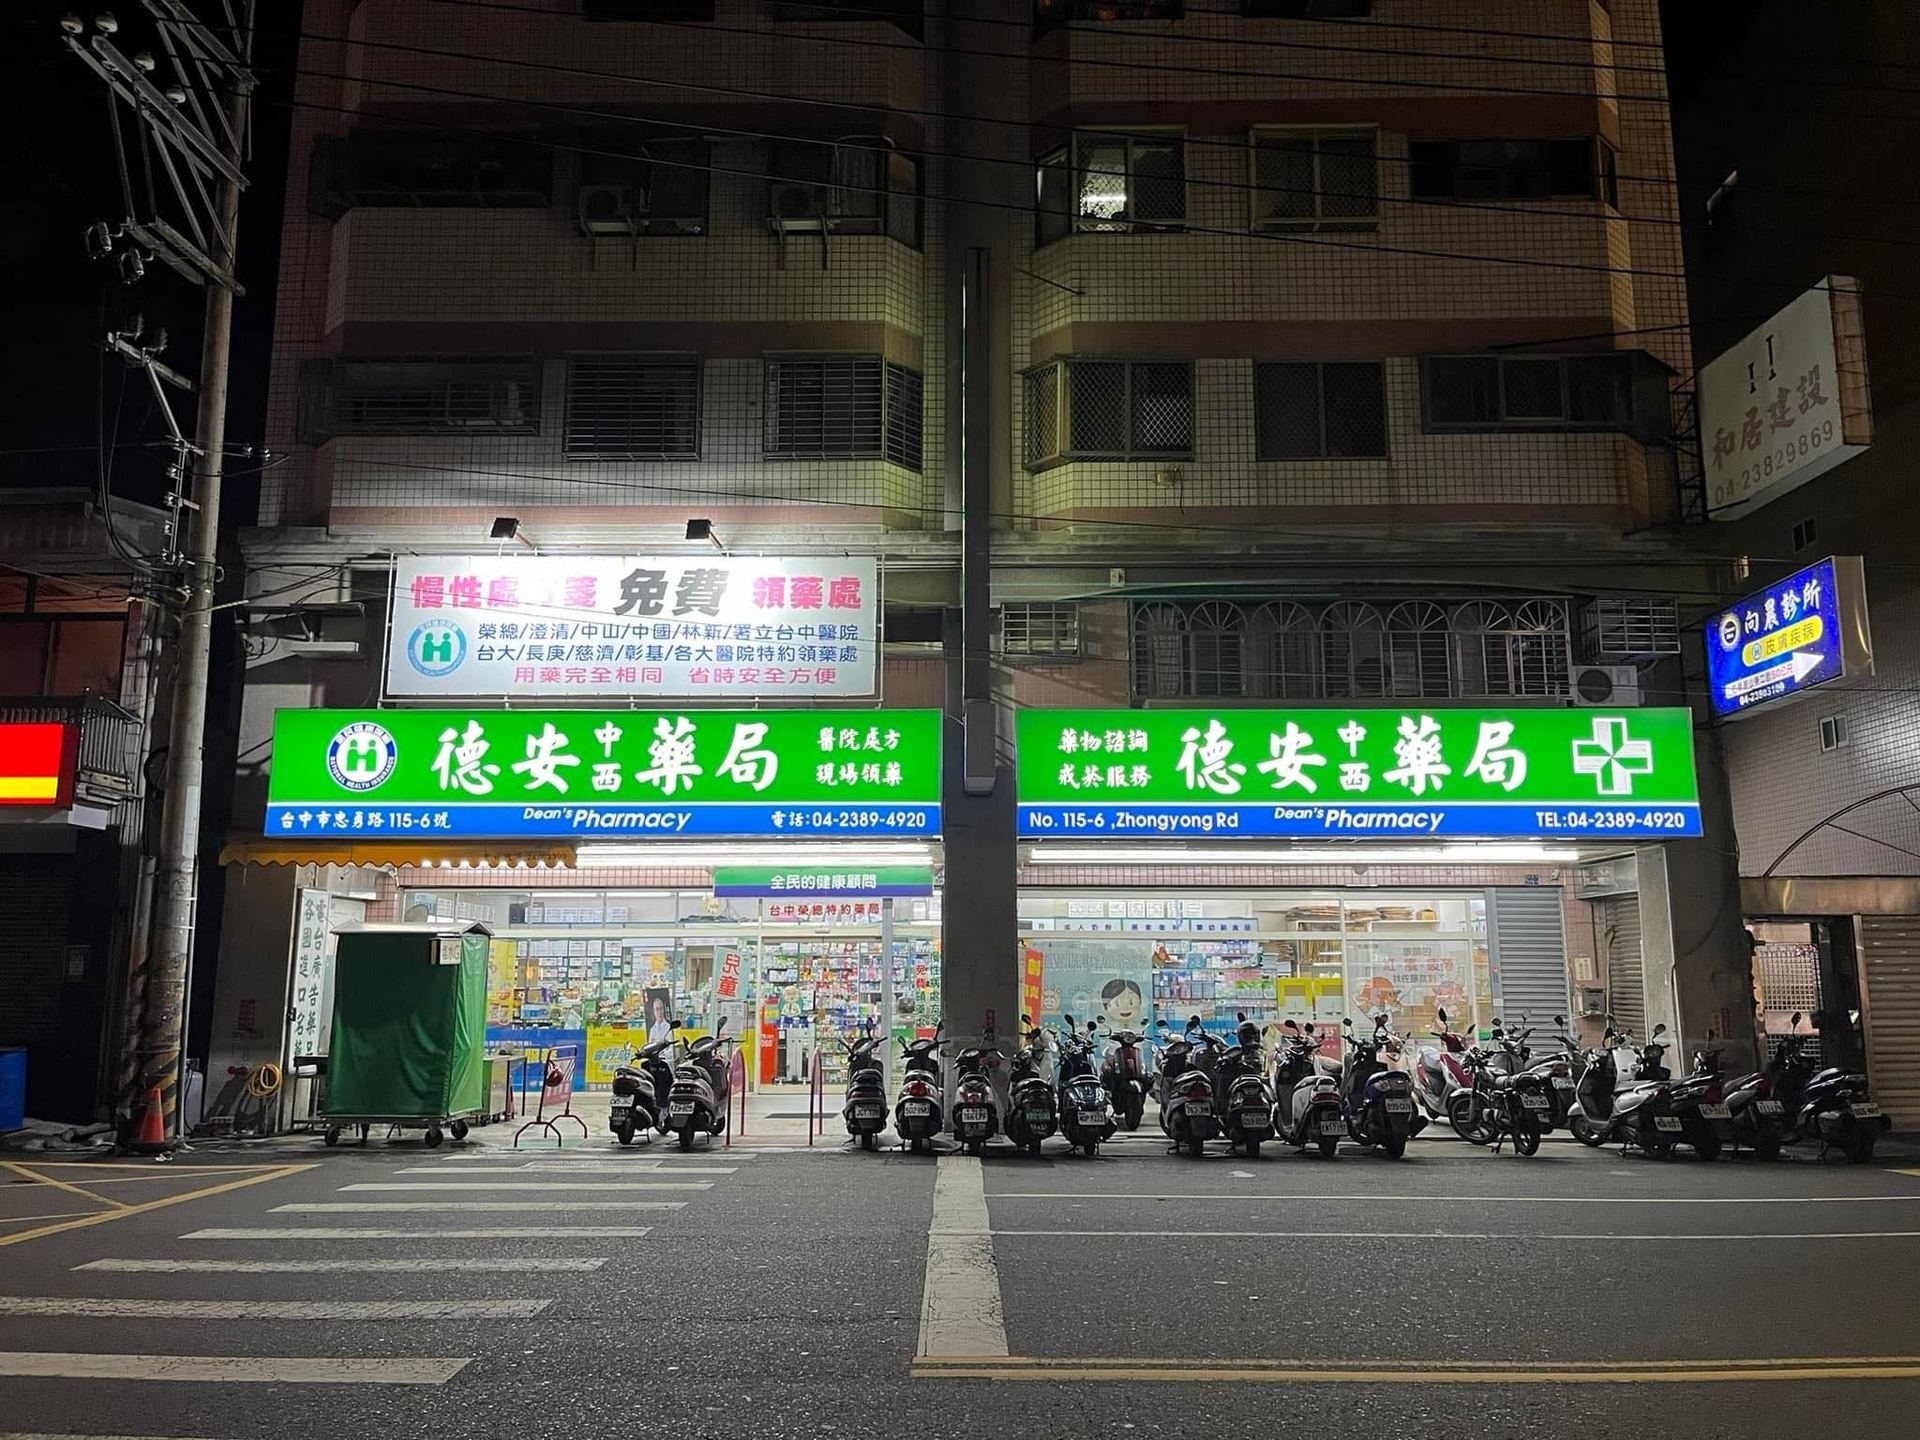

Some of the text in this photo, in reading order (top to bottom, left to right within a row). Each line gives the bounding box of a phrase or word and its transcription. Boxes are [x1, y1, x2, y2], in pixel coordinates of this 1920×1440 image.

[612, 567, 730, 617] 免費
[753, 576, 862, 610] 領藥處
[514, 666, 837, 684] 用藥完全相同 省時安全方便
[817, 726, 902, 752] 醫院處方
[1057, 727, 1149, 754] 藥物諮詢
[816, 761, 903, 787] 現場領藥
[1057, 763, 1152, 790] 戒菸服務
[523, 807, 692, 832] Dean's Pharmacy
[1029, 811, 1058, 828] No.
[1062, 811, 1105, 828] 115-6
[1217, 811, 1239, 828] Rd
[1273, 807, 1445, 832] Dean's Pharmacy
[1535, 811, 1686, 829] TEL:04-2389-4920
[769, 874, 878, 891] 全民的健康顧問
[769, 903, 882, 917] 台中榮總特約藥局
[716, 952, 742, 998] 兒童
